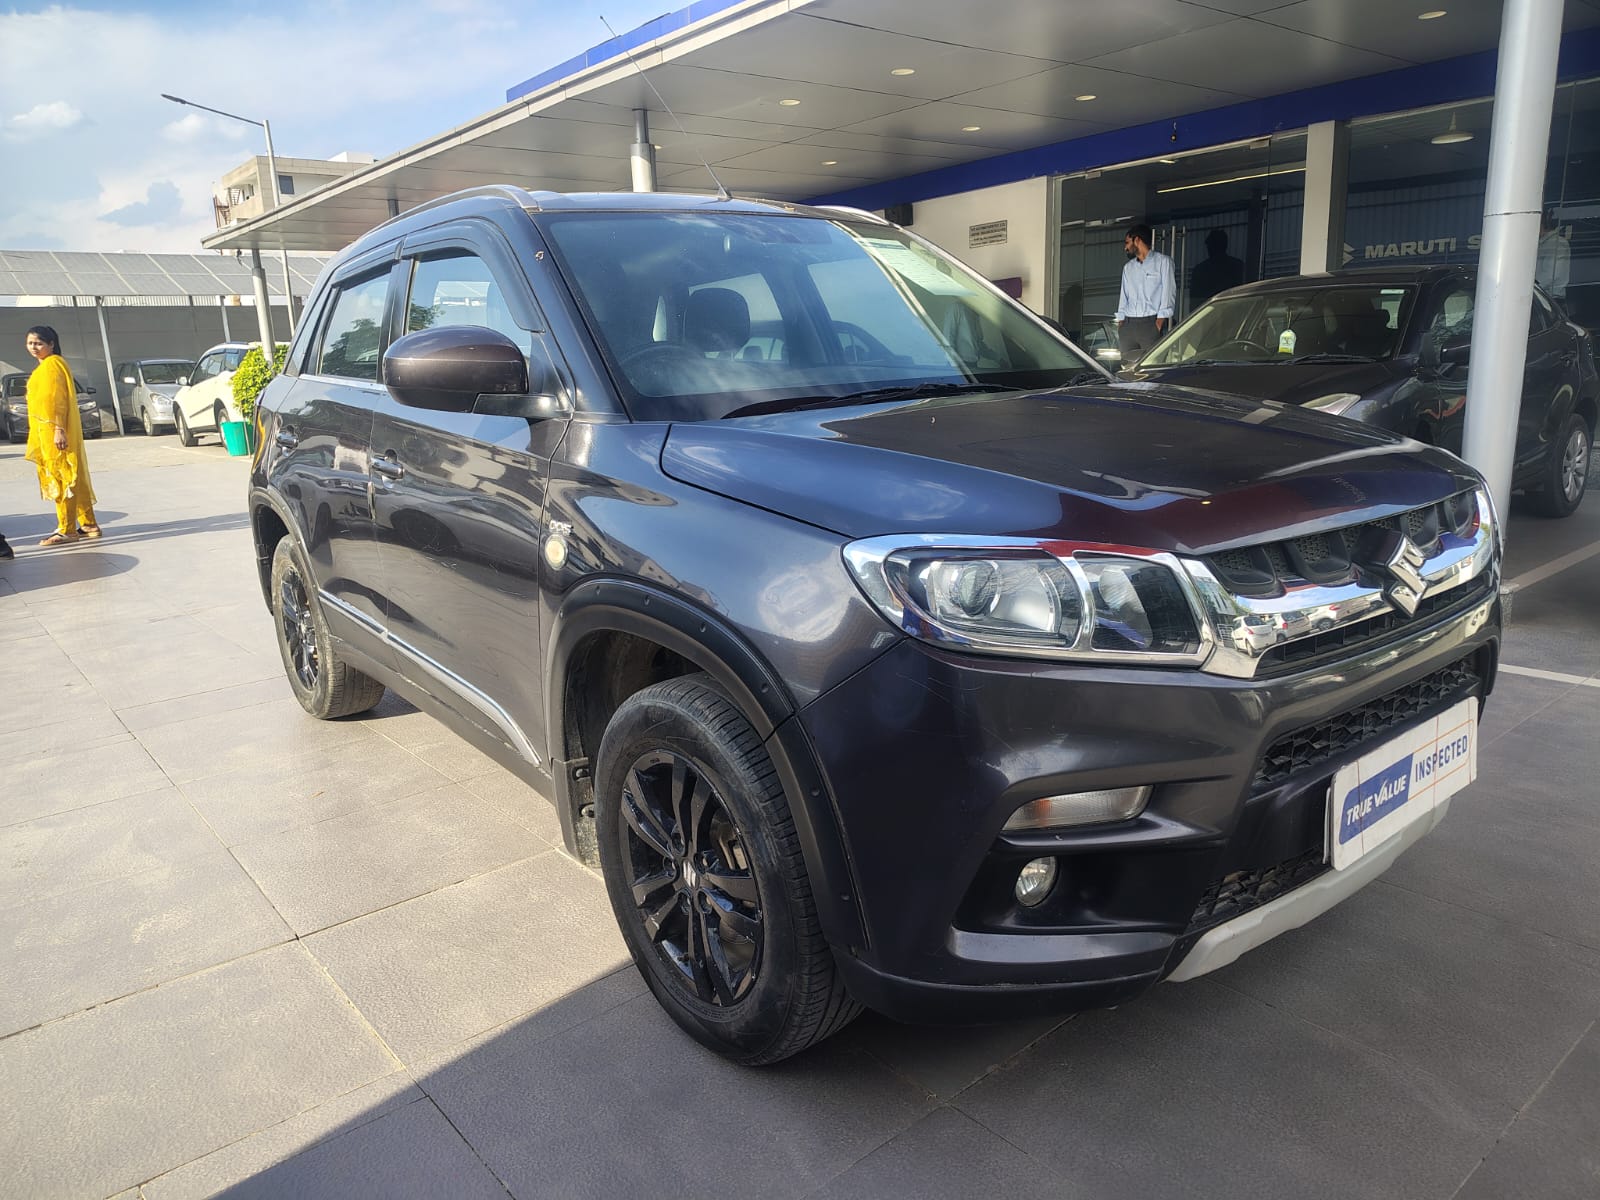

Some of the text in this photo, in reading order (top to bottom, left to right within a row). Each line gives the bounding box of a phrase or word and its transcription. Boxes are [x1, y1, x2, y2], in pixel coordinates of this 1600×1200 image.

[1365, 237, 1457, 259] MARUTI
[1346, 734, 1468, 826] TRUE VALUE INSPECTED
